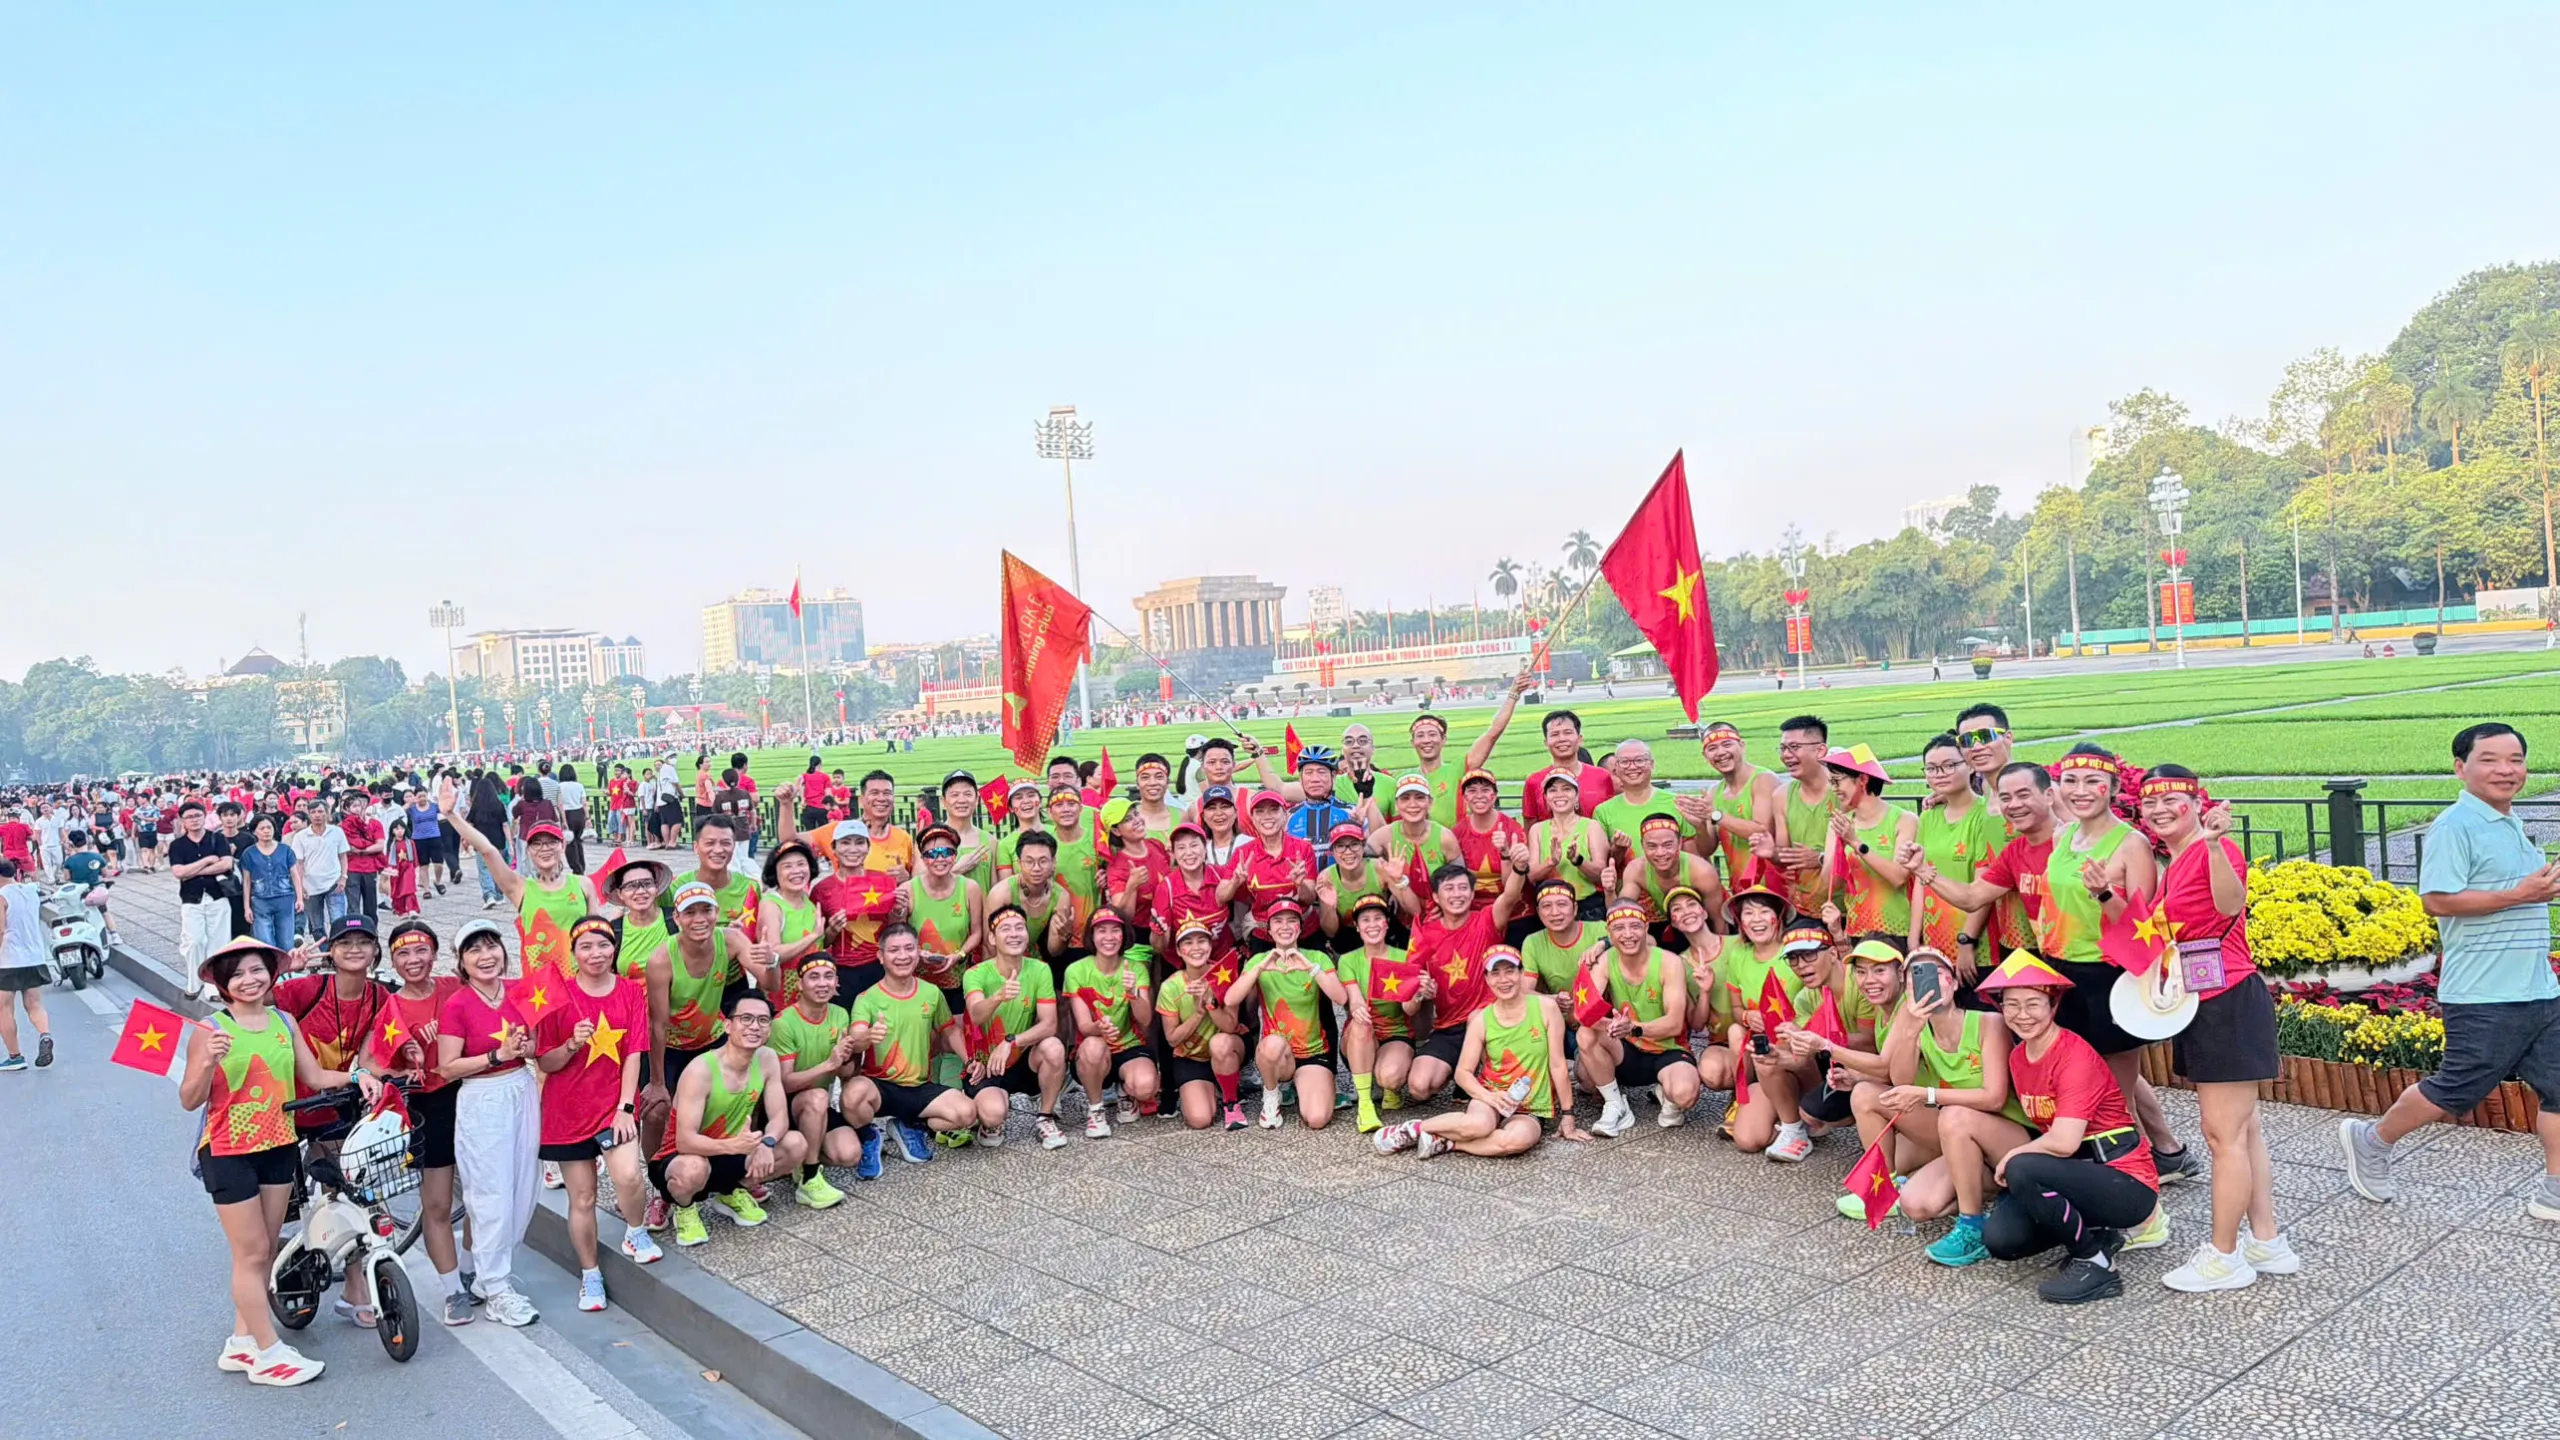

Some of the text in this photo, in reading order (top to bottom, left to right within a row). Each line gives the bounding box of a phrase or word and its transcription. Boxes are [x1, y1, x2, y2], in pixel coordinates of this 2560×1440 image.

[1037, 604, 1054, 634] club
[2153, 780, 2170, 793] VIỆT
[2171, 781, 2187, 791] NAM
